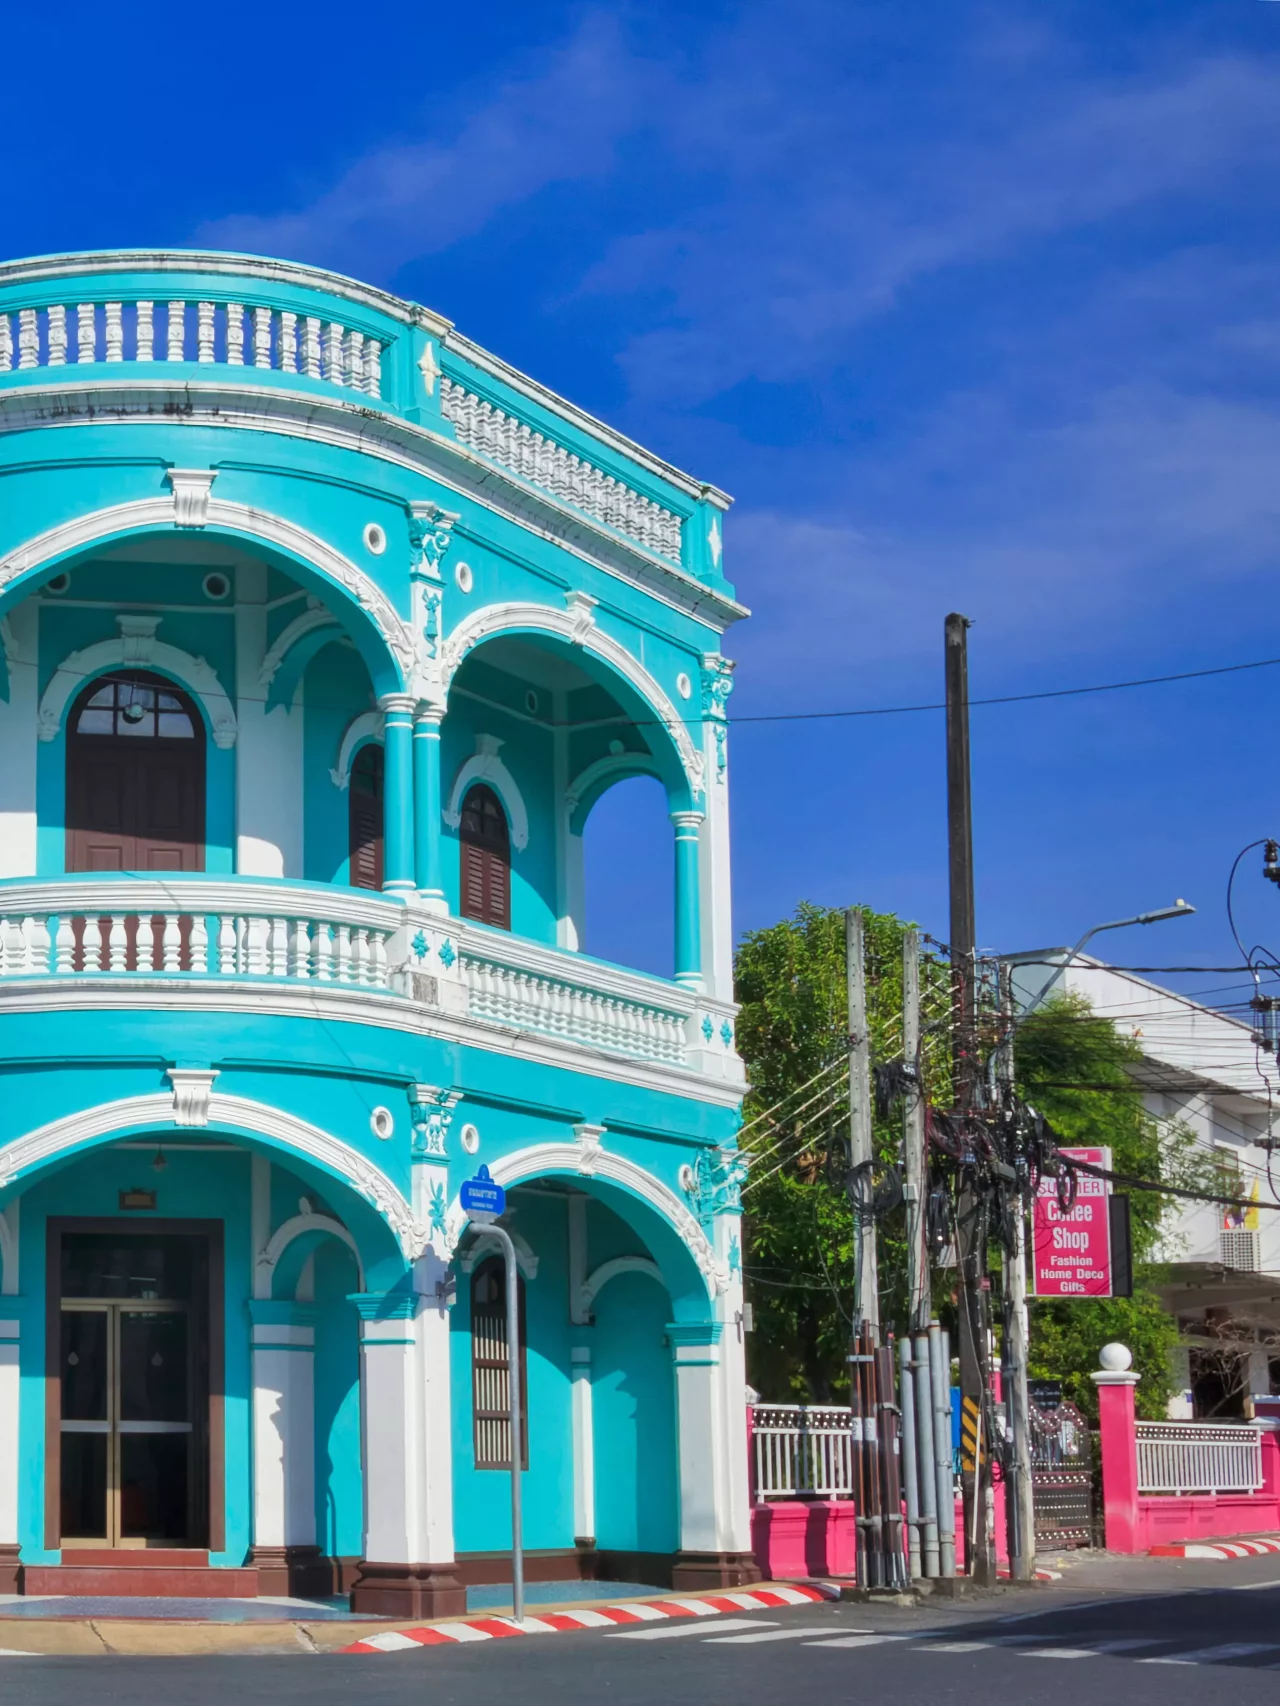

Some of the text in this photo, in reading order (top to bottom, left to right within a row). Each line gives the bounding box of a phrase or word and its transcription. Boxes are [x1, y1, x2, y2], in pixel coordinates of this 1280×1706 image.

[1037, 1181, 1100, 1195] SUER
[1052, 1226, 1089, 1254] Shop
[1050, 1255, 1093, 1266] Fashion
[1040, 1268, 1104, 1279] Home Deco
[1060, 1281, 1086, 1292] Gifts
